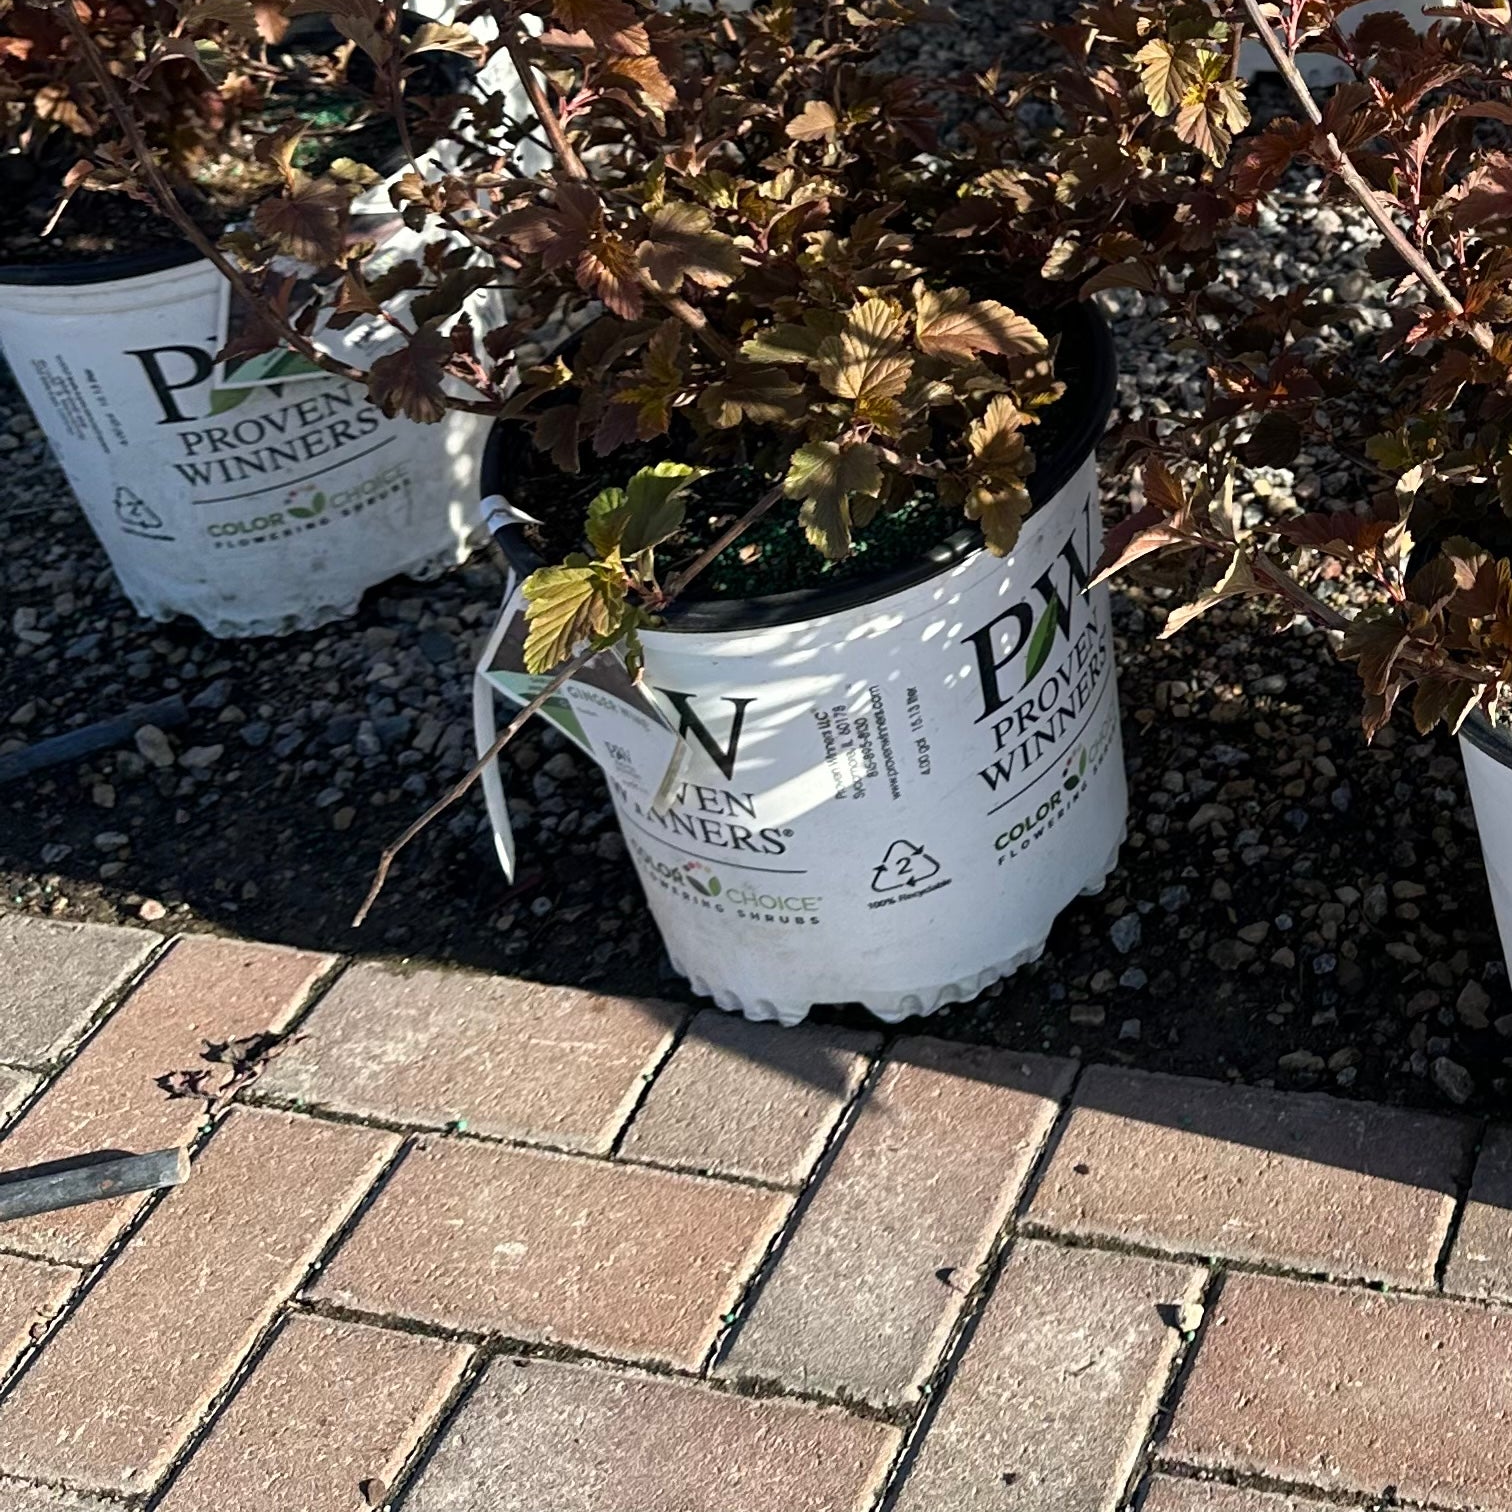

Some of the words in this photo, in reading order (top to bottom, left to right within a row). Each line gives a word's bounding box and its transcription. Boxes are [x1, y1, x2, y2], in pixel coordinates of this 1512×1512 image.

[173, 406, 380, 487] WINNERS
[177, 383, 354, 457] PROVEN
[207, 512, 285, 537] COLOR
[960, 491, 1092, 725] PW
[990, 604, 1098, 754] PROVEN
[994, 789, 1062, 851] COLOR
[998, 780, 1087, 866] FLOWERING
[896, 857, 913, 875] 2
[726, 888, 819, 912] CHOICE
[737, 909, 820, 925] SHRUBS
[867, 896, 897, 910] 100%
